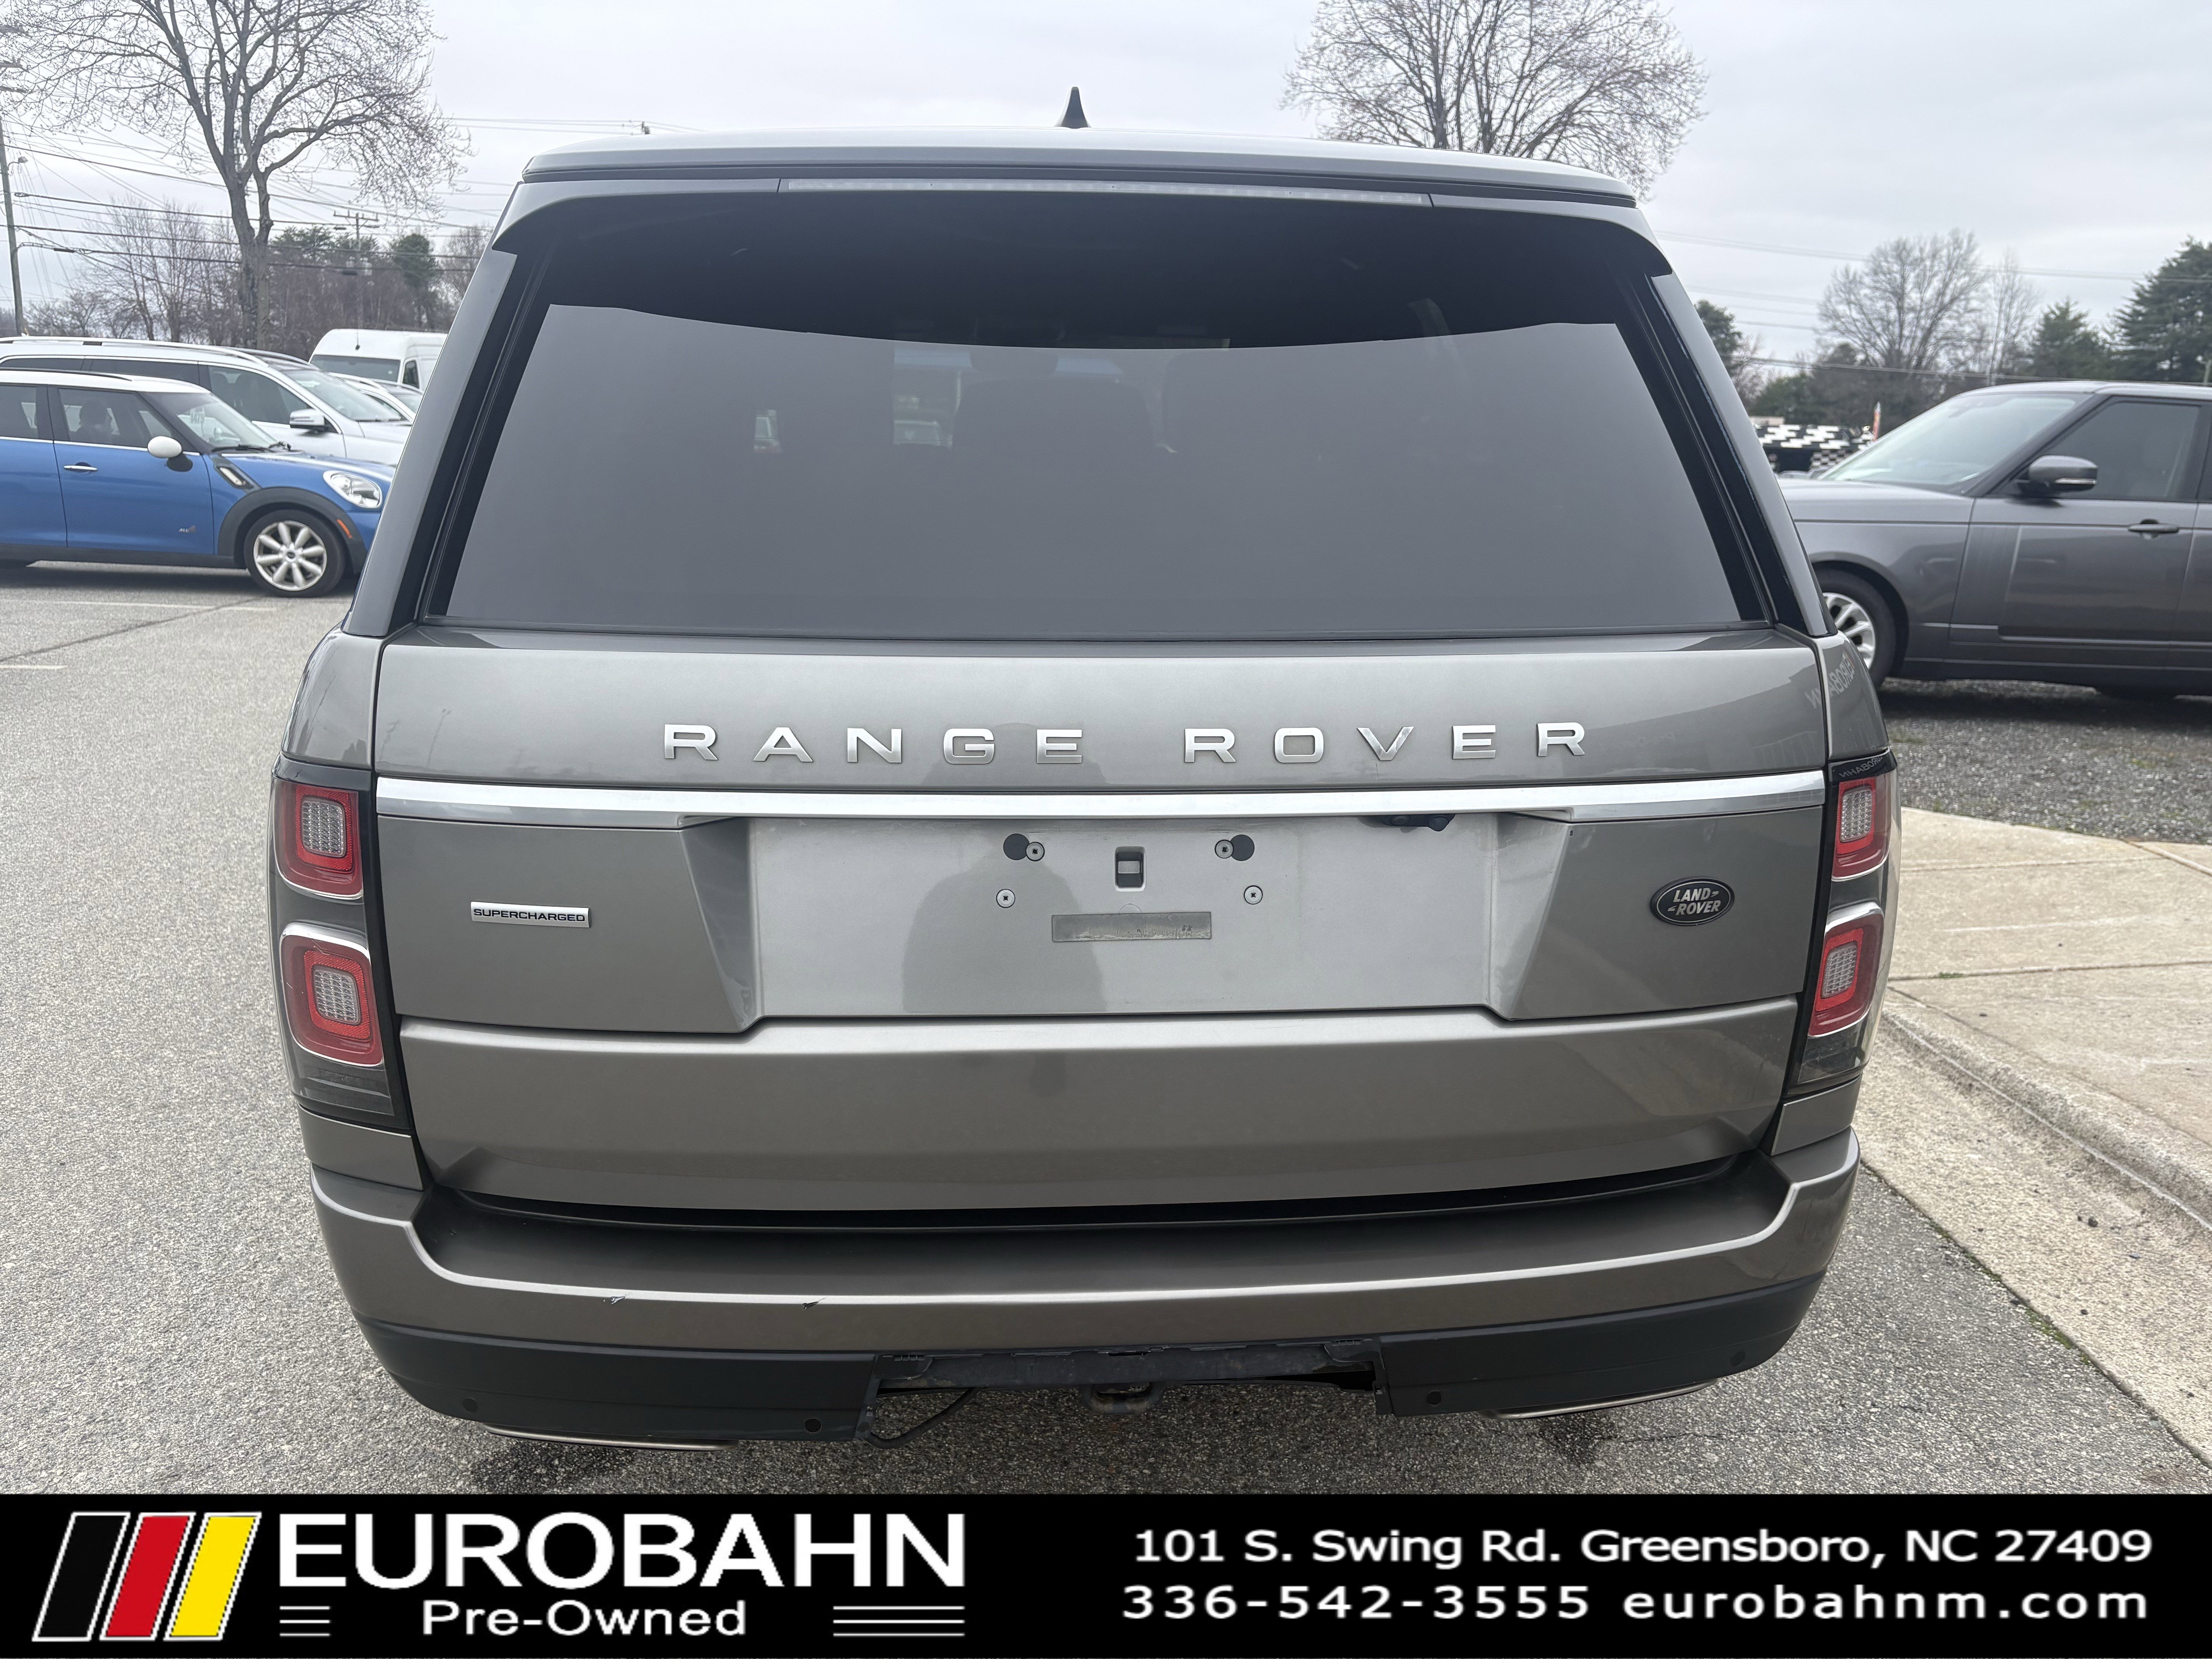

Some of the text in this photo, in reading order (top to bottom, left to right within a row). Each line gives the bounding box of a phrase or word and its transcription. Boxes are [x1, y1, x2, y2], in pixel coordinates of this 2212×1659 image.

[664, 723, 1083, 764] RANGE
[1184, 722, 1585, 763] ROVER
[473, 908, 586, 922] SUPERCHARGED
